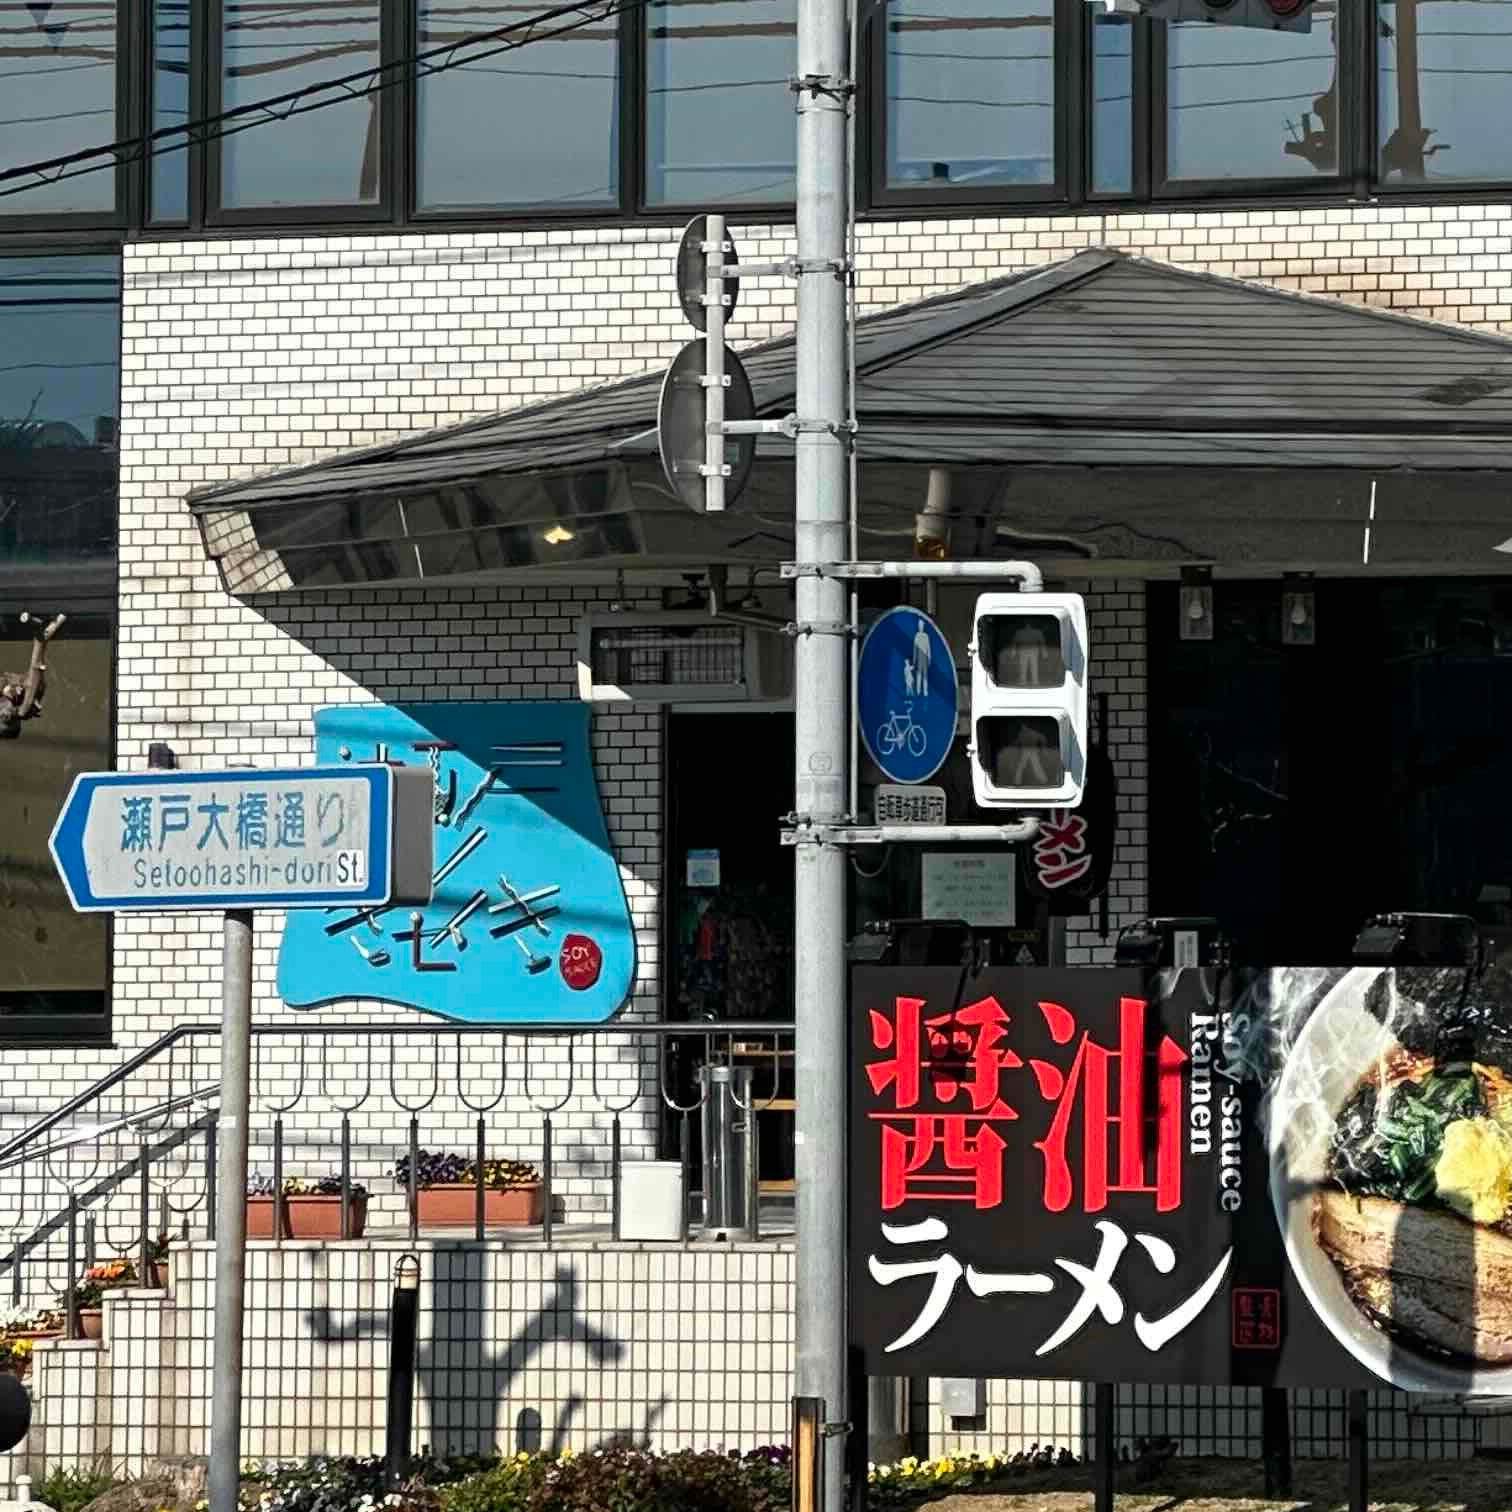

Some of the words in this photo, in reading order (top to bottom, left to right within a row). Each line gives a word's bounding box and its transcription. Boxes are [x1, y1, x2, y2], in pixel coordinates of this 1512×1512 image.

[121, 792, 345, 852] 瀬戸大橋通り
[337, 852, 364, 885] St.
[864, 995, 1190, 1213] 醤油
[1190, 1012, 1219, 1155] Ramen
[1213, 1012, 1250, 1212] Soy-sauce
[868, 1218, 1234, 1356] ラーメン
